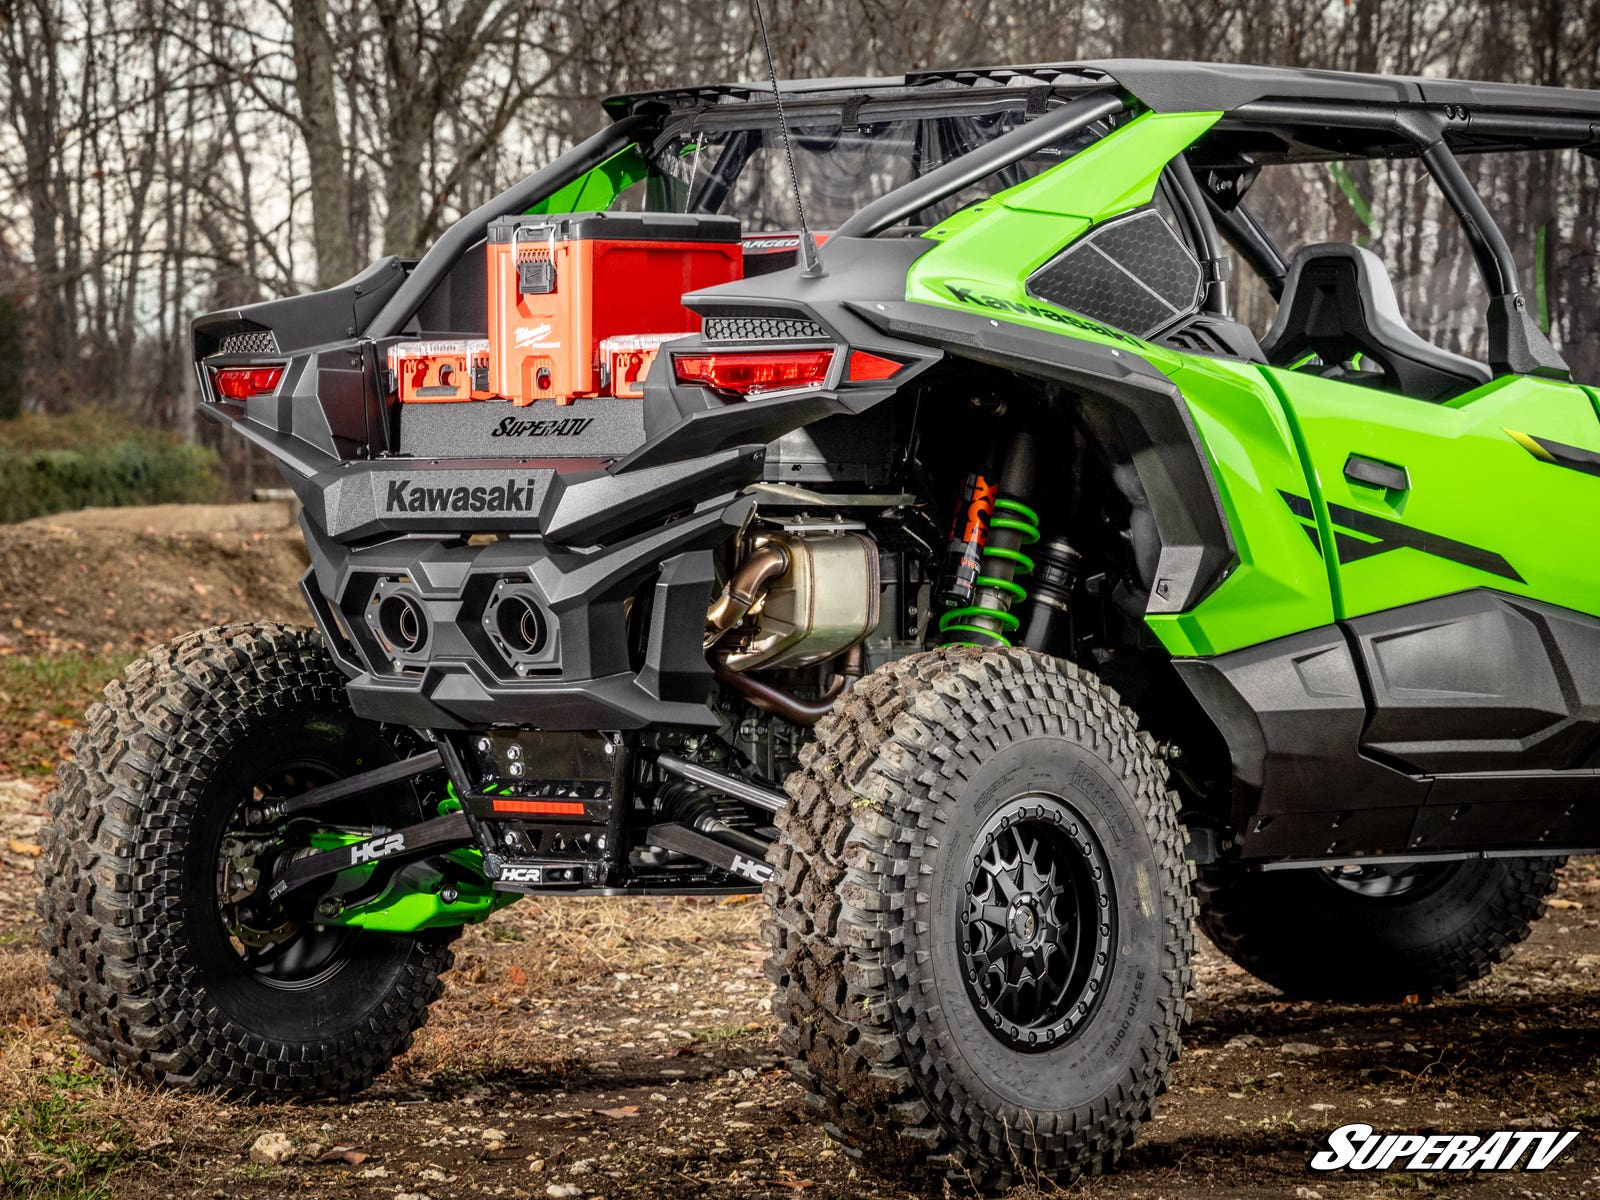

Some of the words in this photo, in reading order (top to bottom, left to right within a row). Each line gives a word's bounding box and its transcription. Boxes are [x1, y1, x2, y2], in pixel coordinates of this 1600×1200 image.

[743, 238, 800, 249] ARGED
[943, 283, 1148, 351] Kawasaki
[386, 478, 536, 513] Kawasaki
[350, 832, 406, 865] HCR
[500, 868, 541, 882] HCR
